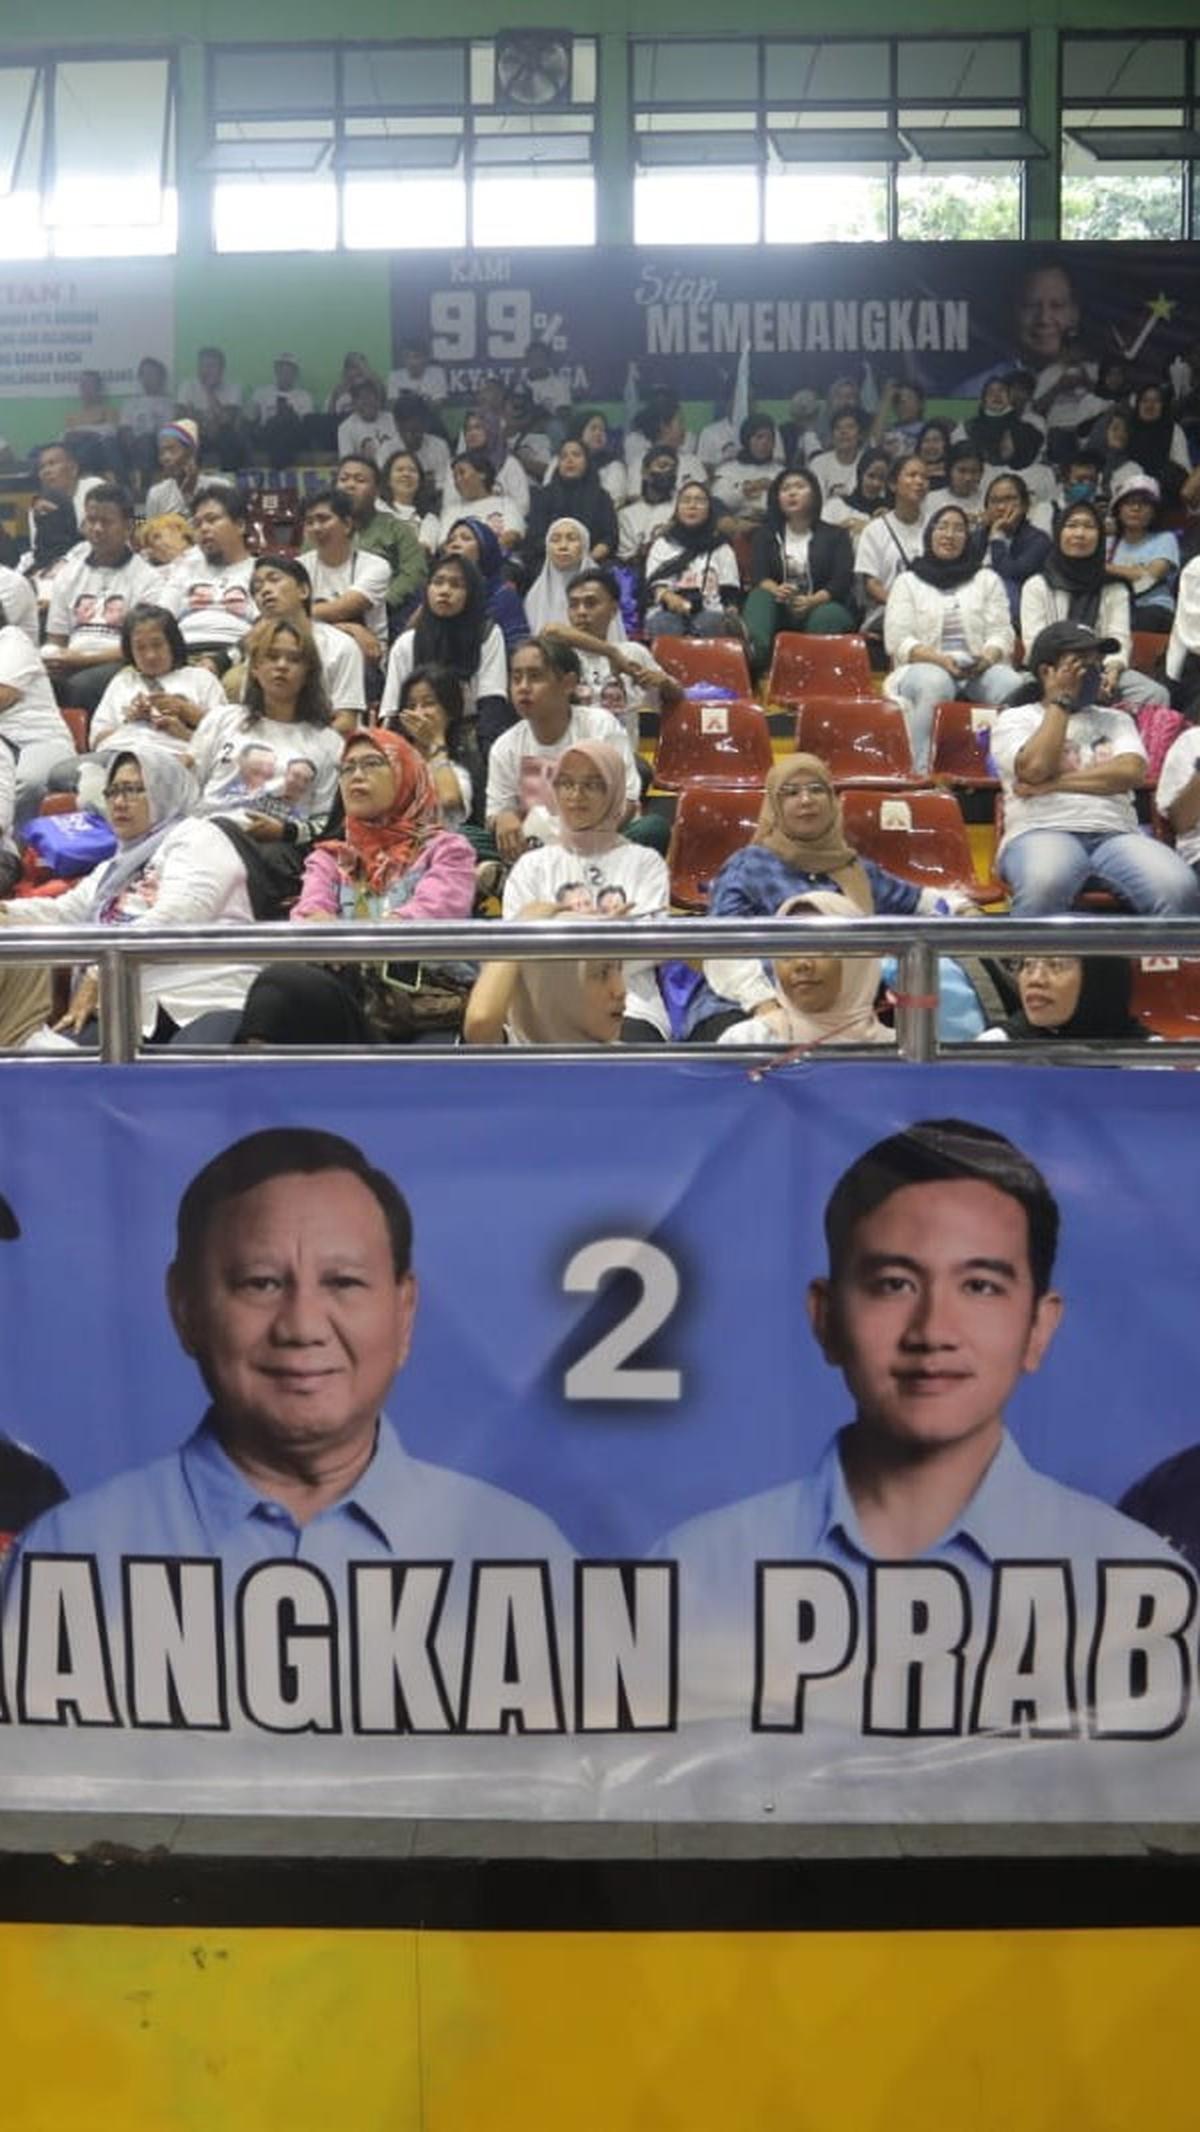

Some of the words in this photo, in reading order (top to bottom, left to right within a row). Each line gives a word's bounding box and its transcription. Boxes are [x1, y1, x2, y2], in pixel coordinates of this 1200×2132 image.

[450, 255, 511, 282] KAMI
[0, 282, 62, 304] IAN
[647, 300, 969, 353] MEMENANGKAN
[221, 742, 235, 764] 2
[561, 1238, 682, 1400] 2
[0, 1552, 678, 1734] ANGKAN
[753, 1558, 1200, 1743] PRAB
